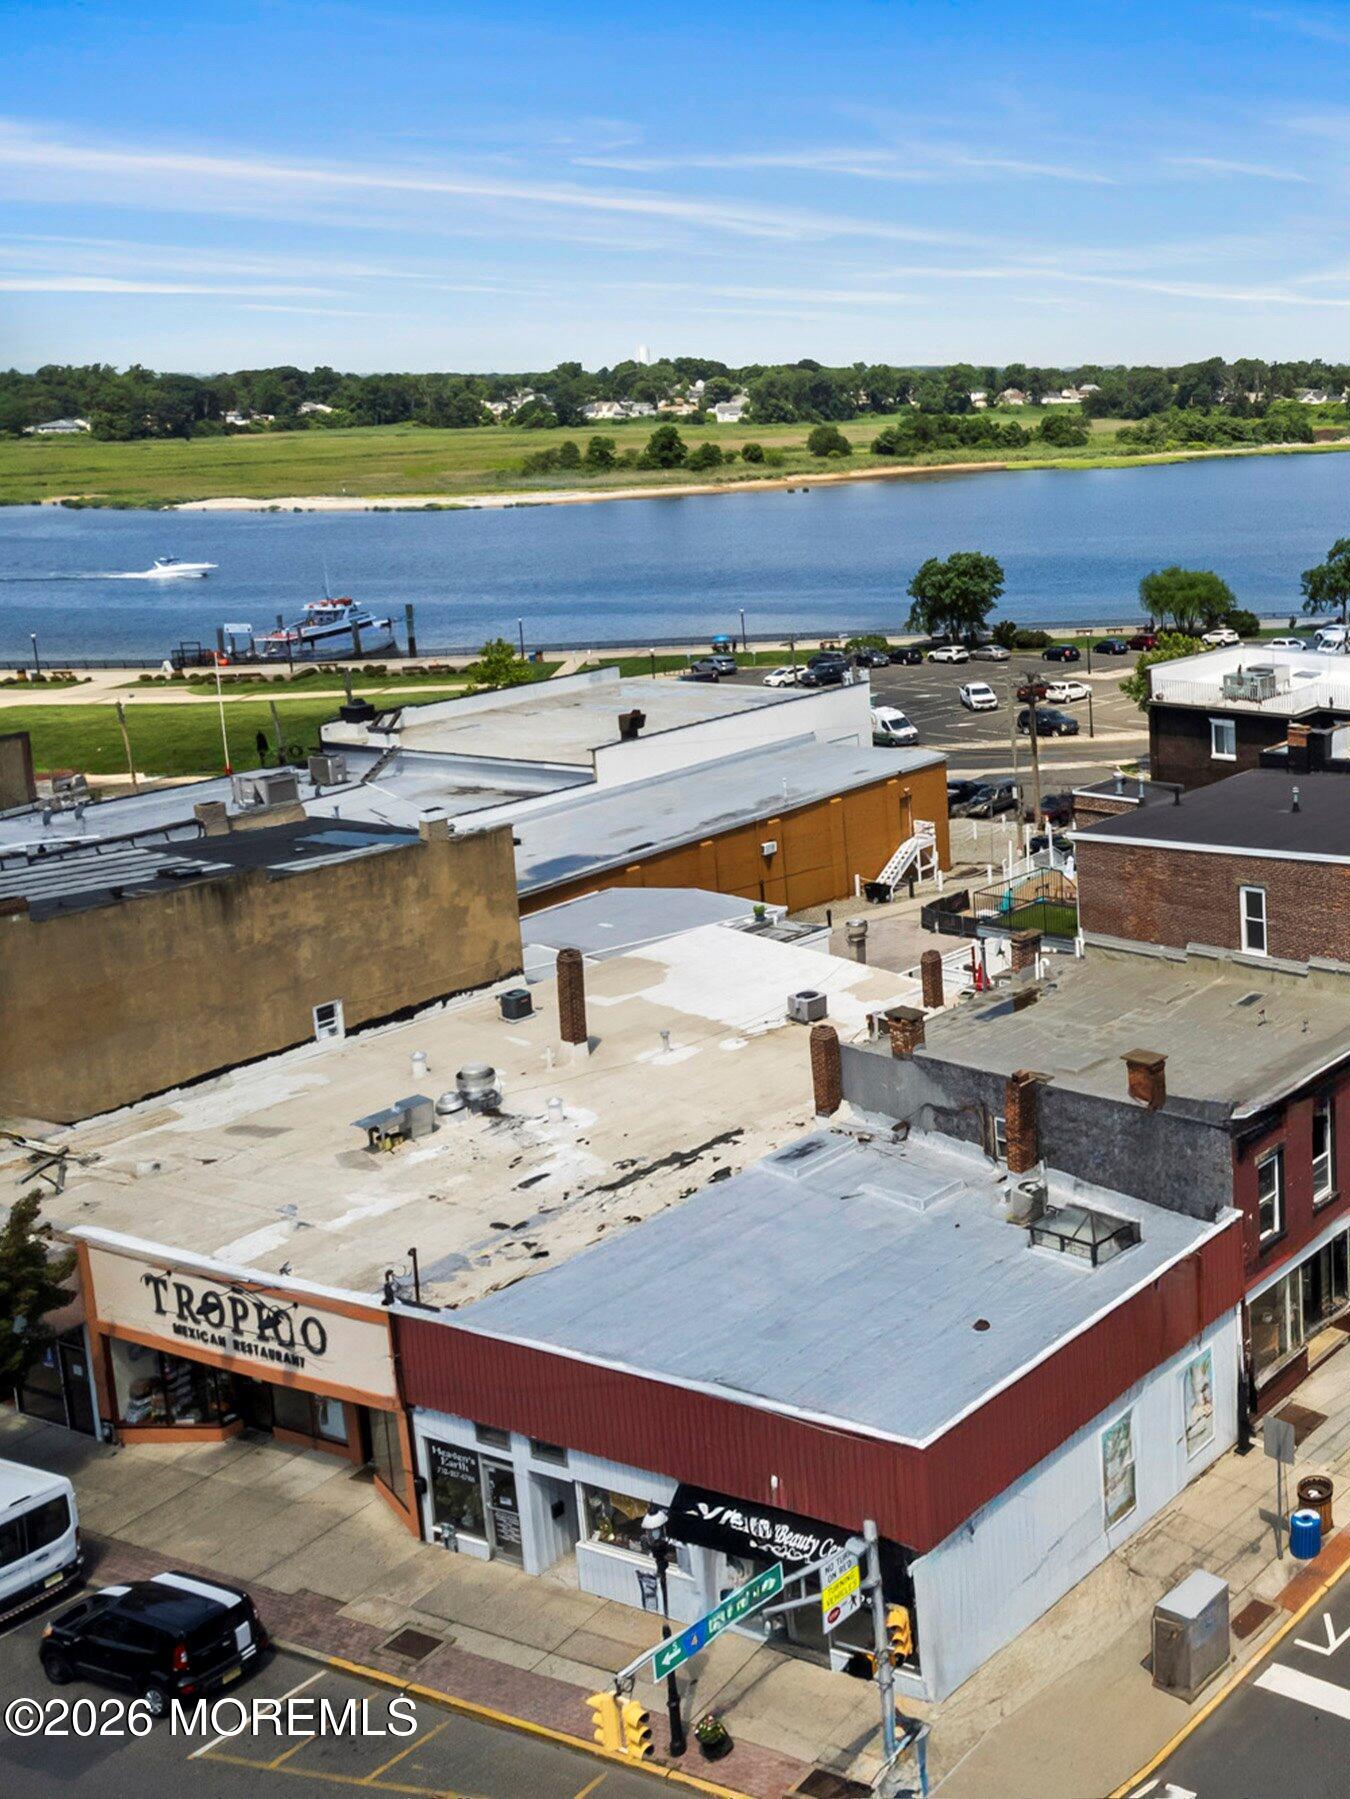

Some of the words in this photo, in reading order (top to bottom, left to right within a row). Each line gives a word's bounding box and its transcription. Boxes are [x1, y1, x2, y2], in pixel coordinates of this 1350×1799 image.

[172, 1322, 226, 1347] MEXICAN
[233, 1339, 306, 1369] RESTAURANT
[775, 1524, 820, 1558] Beauty
